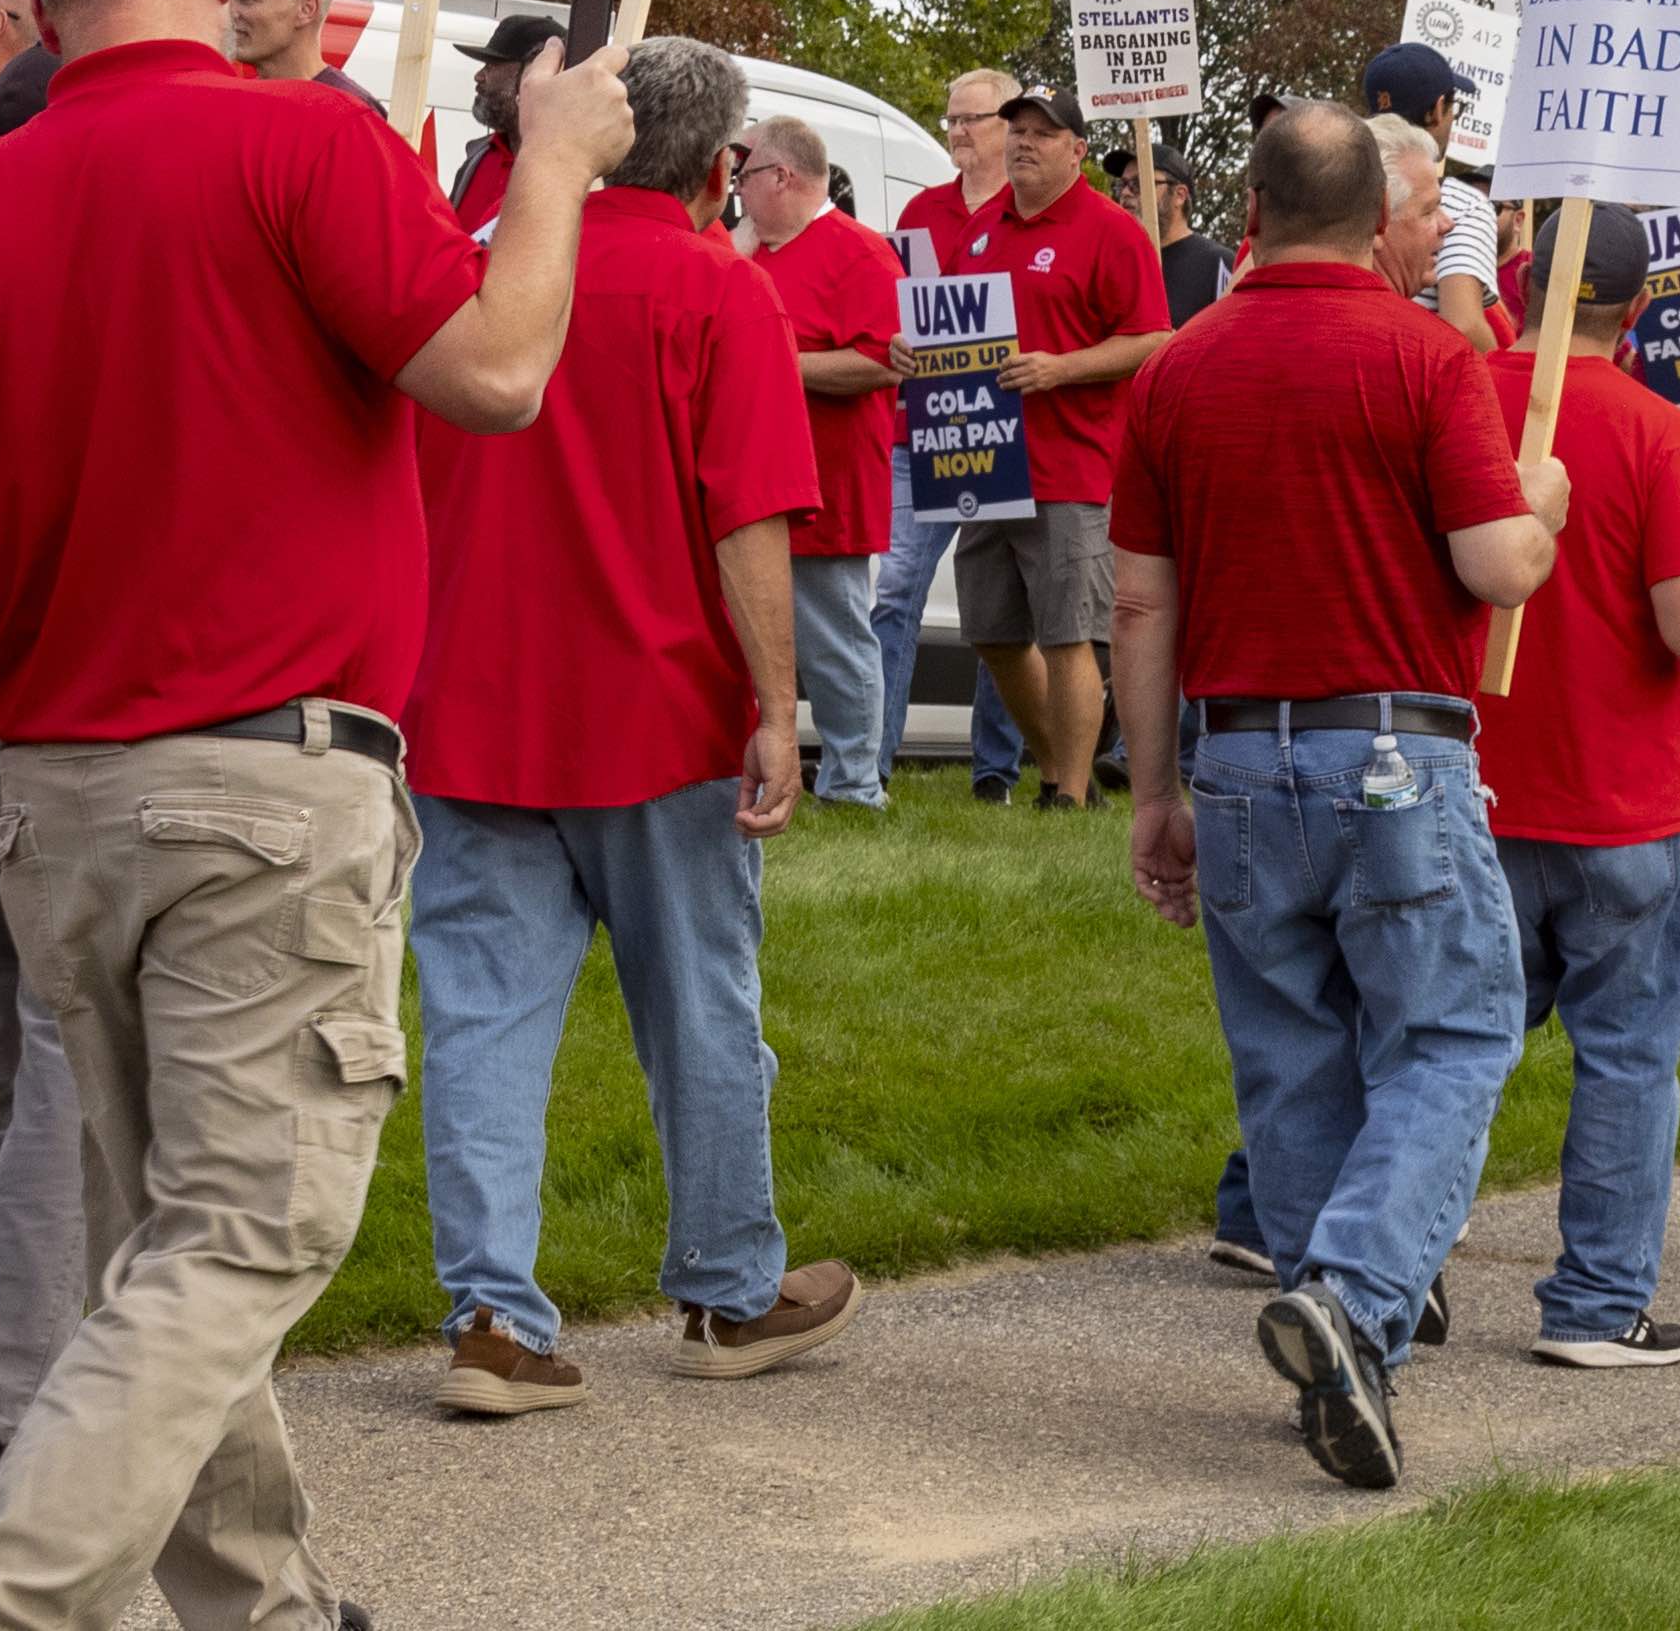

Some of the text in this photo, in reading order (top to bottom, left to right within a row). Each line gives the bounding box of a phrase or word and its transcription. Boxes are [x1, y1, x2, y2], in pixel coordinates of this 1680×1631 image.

[1078, 8, 1190, 27] STELLANTIS
[1428, 16, 1503, 49] UAW 412
[1081, 30, 1192, 50] BARGAINING
[1535, 24, 1578, 67] IN
[1106, 50, 1168, 67] IN BAD
[1448, 57, 1504, 87] LANTIS
[1111, 68, 1166, 84] FAITH
[1534, 88, 1667, 138] FAITH
[912, 282, 989, 337] UAW
[926, 386, 995, 416] COLA
[912, 418, 1018, 453] FAIR PAY
[933, 449, 996, 479] NOW
